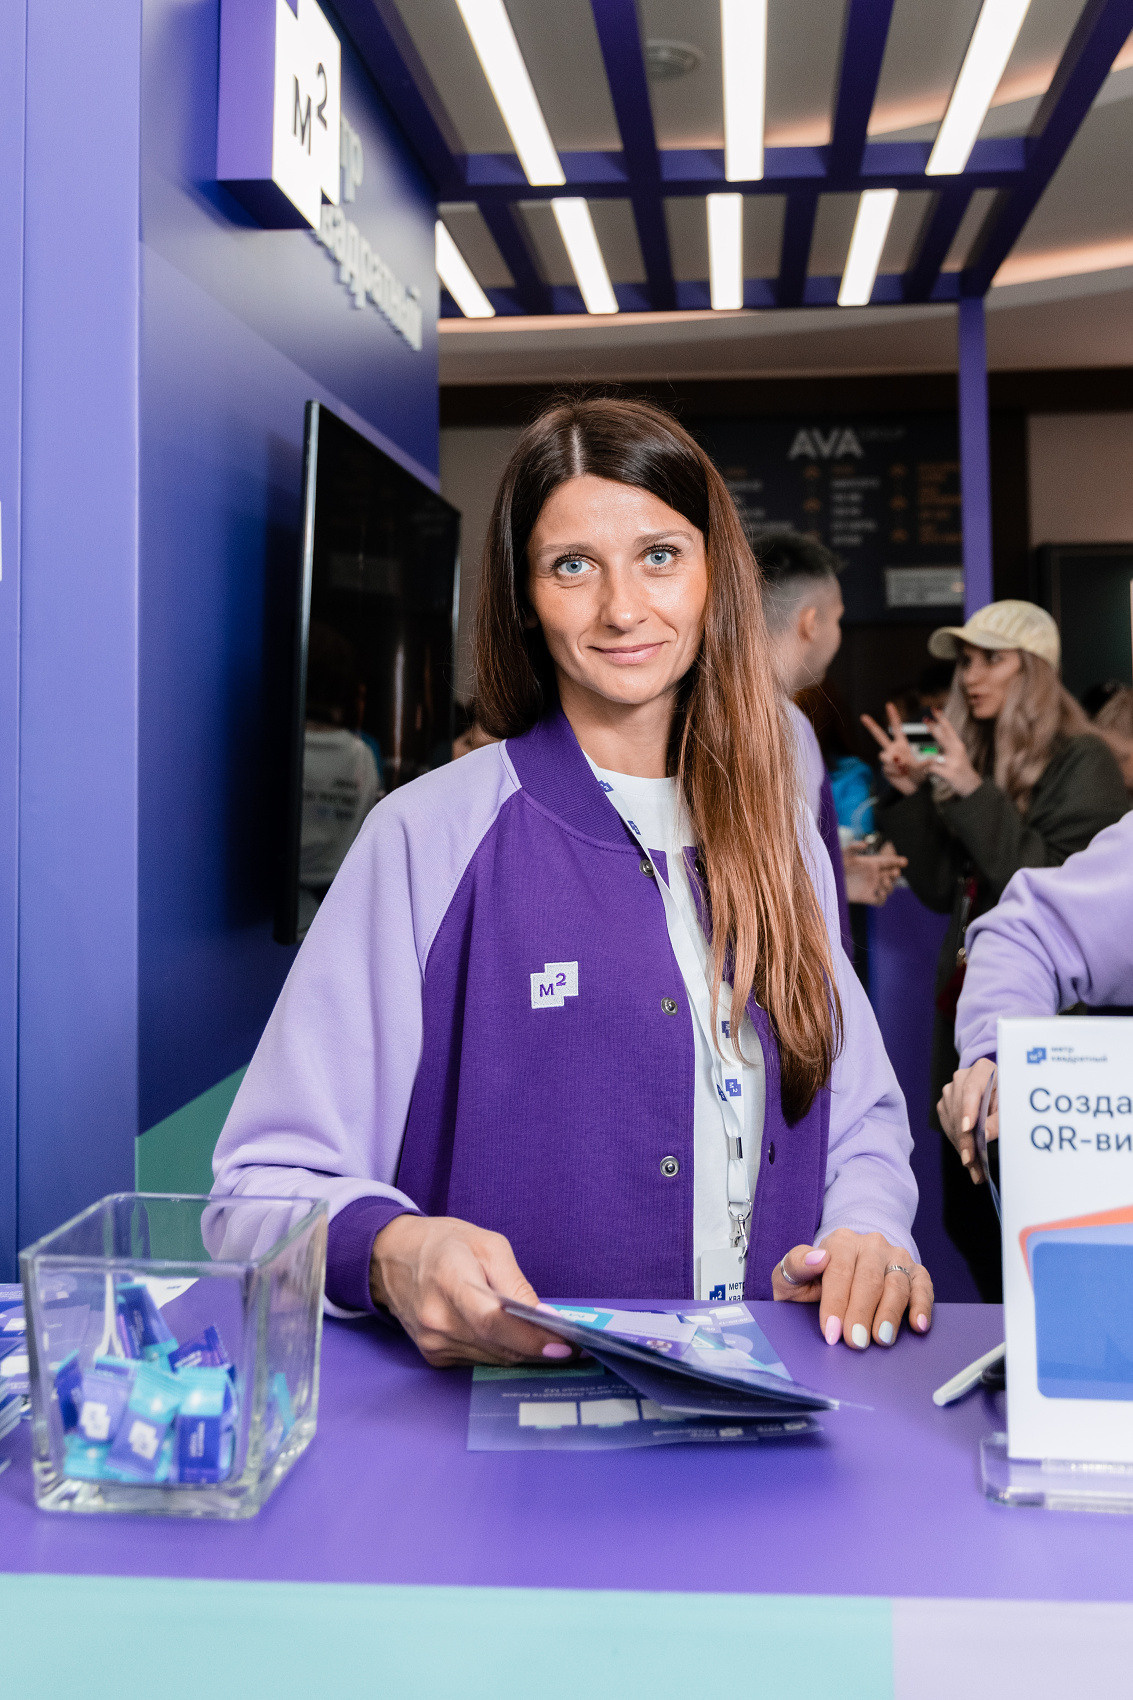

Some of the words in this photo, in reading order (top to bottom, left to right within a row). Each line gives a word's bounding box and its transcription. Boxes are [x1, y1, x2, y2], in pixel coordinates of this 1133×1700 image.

[787, 428, 864, 460] AVA
[1029, 1087, 1133, 1119] Созда
[1030, 1125, 1133, 1153] QR-ви
